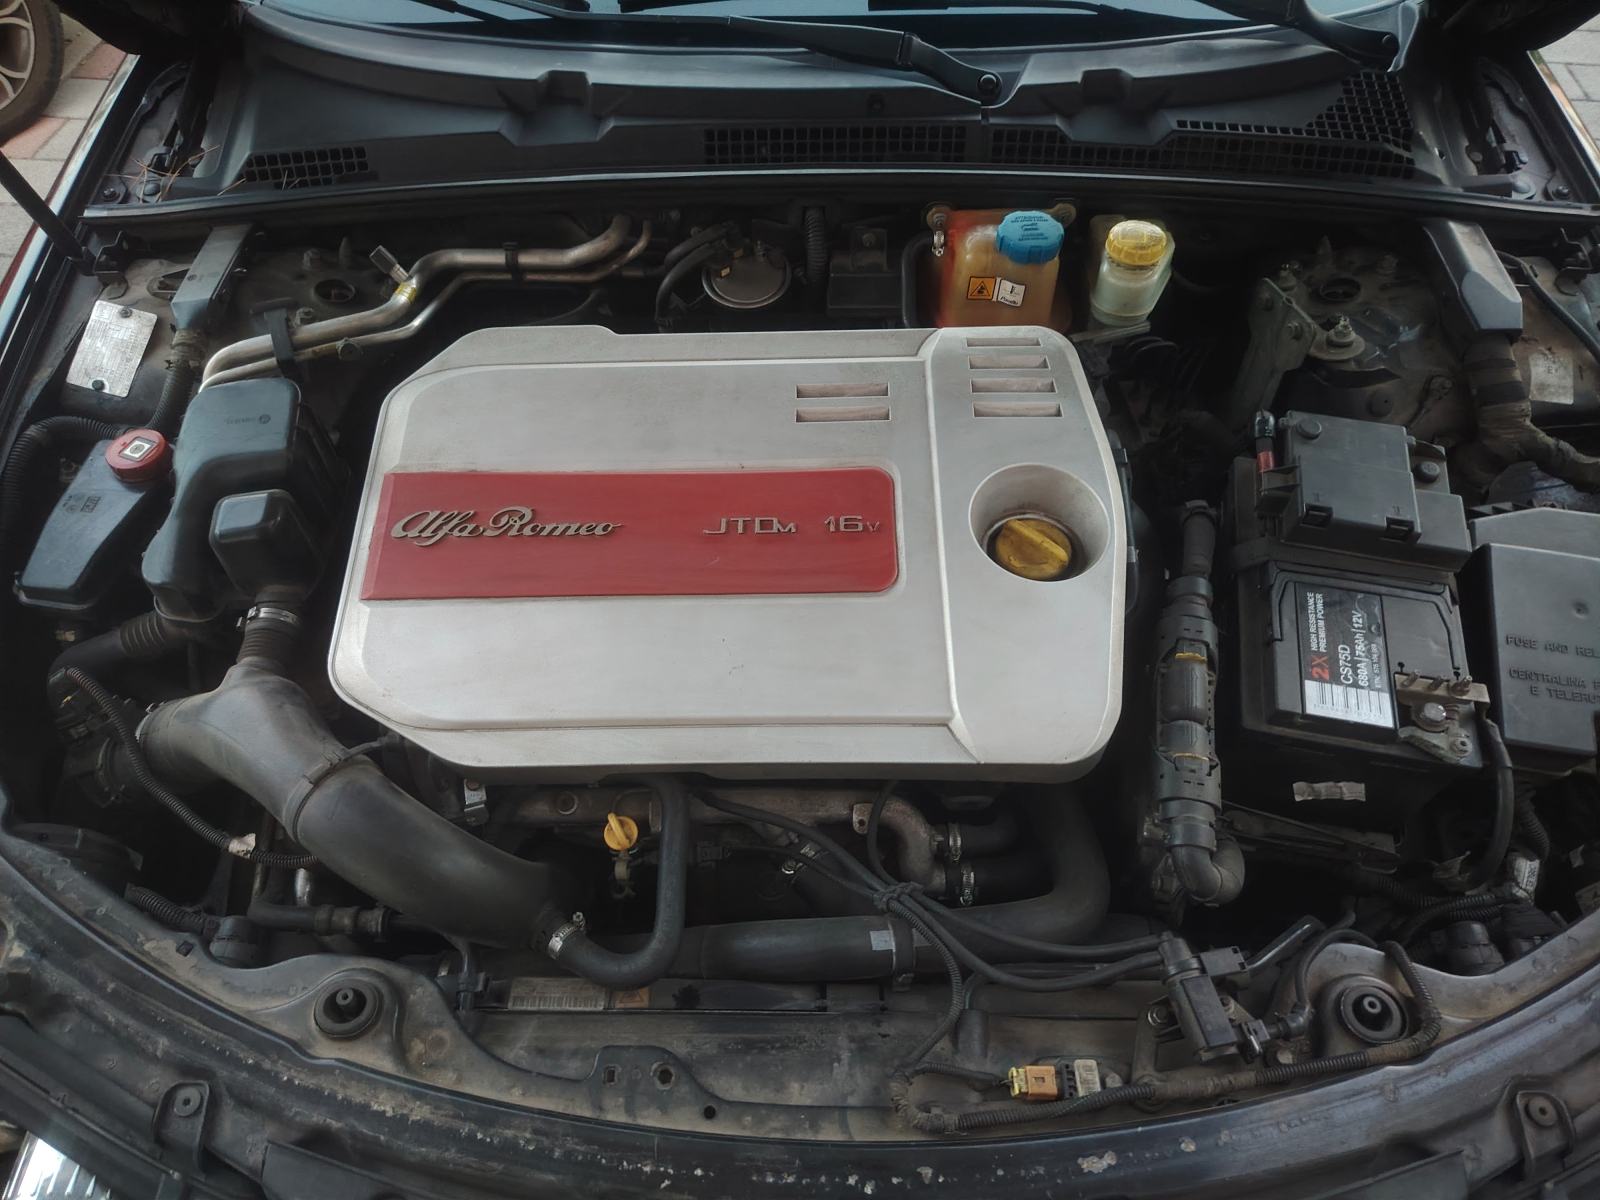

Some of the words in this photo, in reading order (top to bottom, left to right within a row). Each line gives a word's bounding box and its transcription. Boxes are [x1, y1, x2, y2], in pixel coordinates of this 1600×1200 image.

[391, 510, 483, 546] Alfa
[483, 506, 624, 537] Romeo
[1307, 592, 1317, 633] RESISTANCE
[1316, 593, 1324, 619] POWER
[1310, 634, 1318, 651] HIGH
[1318, 619, 1327, 652] PREMIUM
[1505, 635, 1537, 650] FUSE
[1544, 642, 1569, 654] AND
[1311, 655, 1329, 681] 2X
[1338, 644, 1353, 685] CS75D
[1509, 667, 1586, 689] CENTRALINA
[1530, 685, 1539, 696] E
